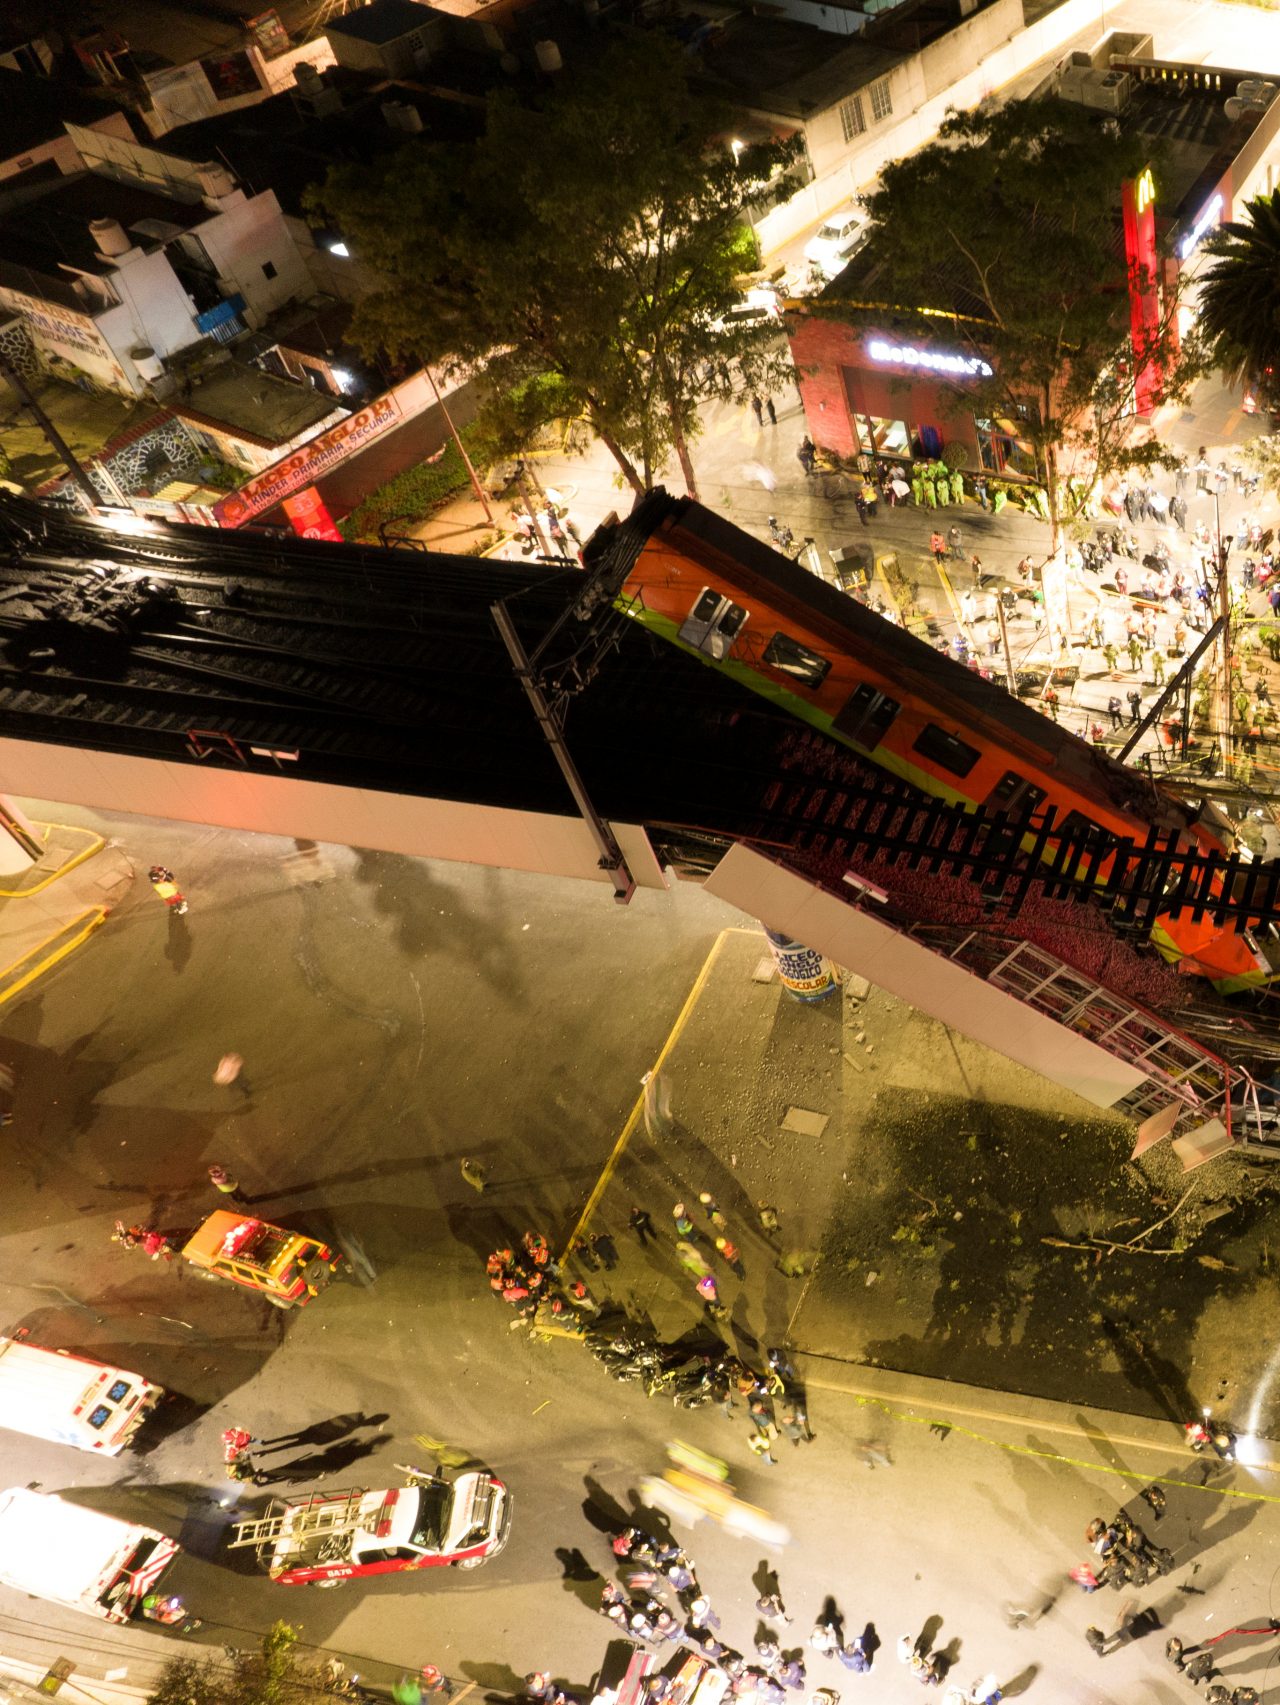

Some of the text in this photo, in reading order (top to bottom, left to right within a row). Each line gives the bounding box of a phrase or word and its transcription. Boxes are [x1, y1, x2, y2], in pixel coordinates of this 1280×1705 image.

[240, 455, 305, 500] LICEO
[306, 414, 370, 459] ANGLO
[251, 408, 396, 507] KINDER PRIMARIA SECUNDA
